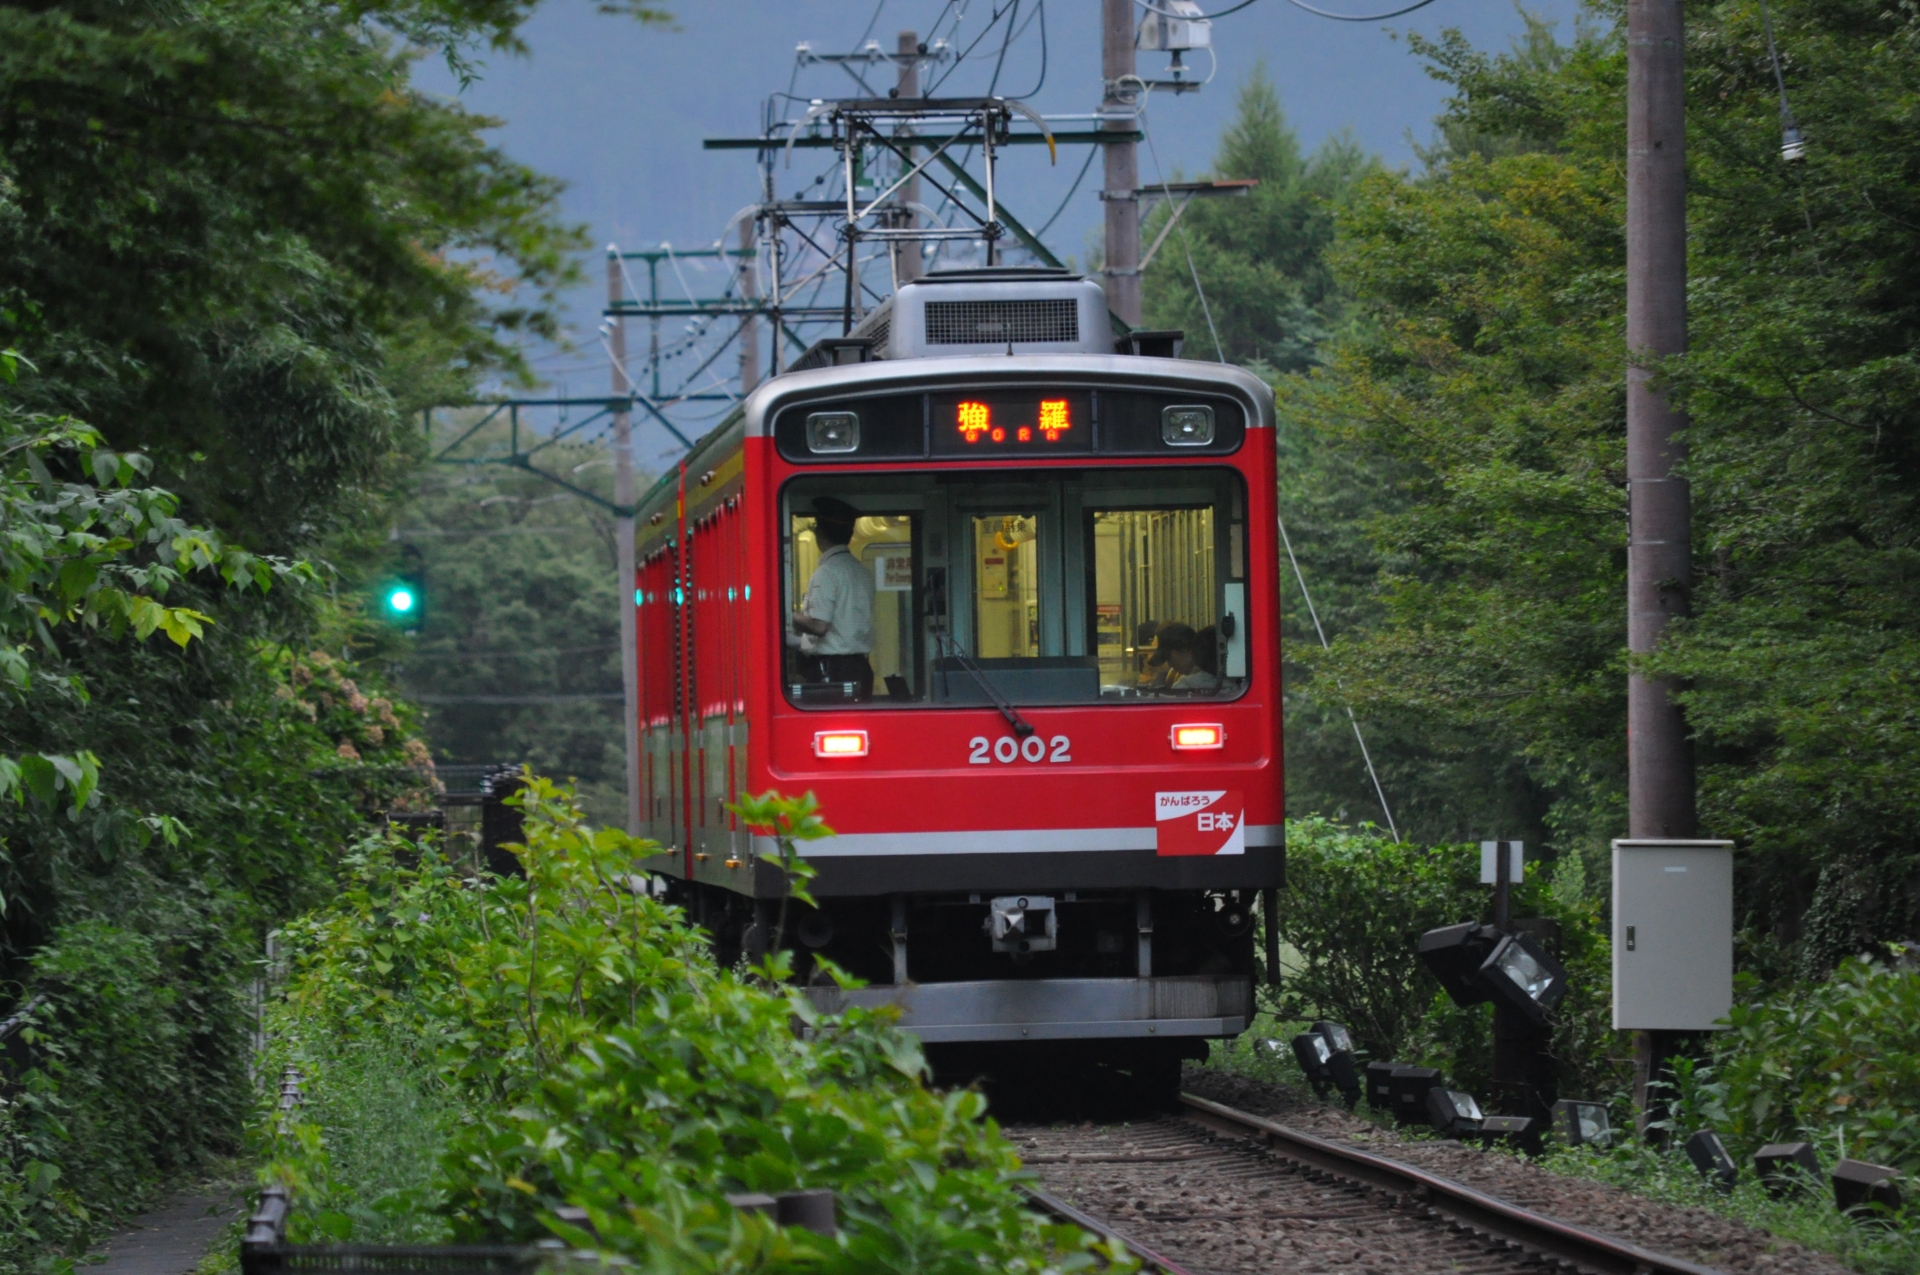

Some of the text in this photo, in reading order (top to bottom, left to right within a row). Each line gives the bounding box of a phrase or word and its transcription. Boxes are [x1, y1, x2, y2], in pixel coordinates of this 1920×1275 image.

[958, 401, 1070, 431] 強羅
[969, 735, 1071, 764] 2002
[1160, 796, 1210, 806] がんばろう
[1197, 812, 1234, 831] 日本
